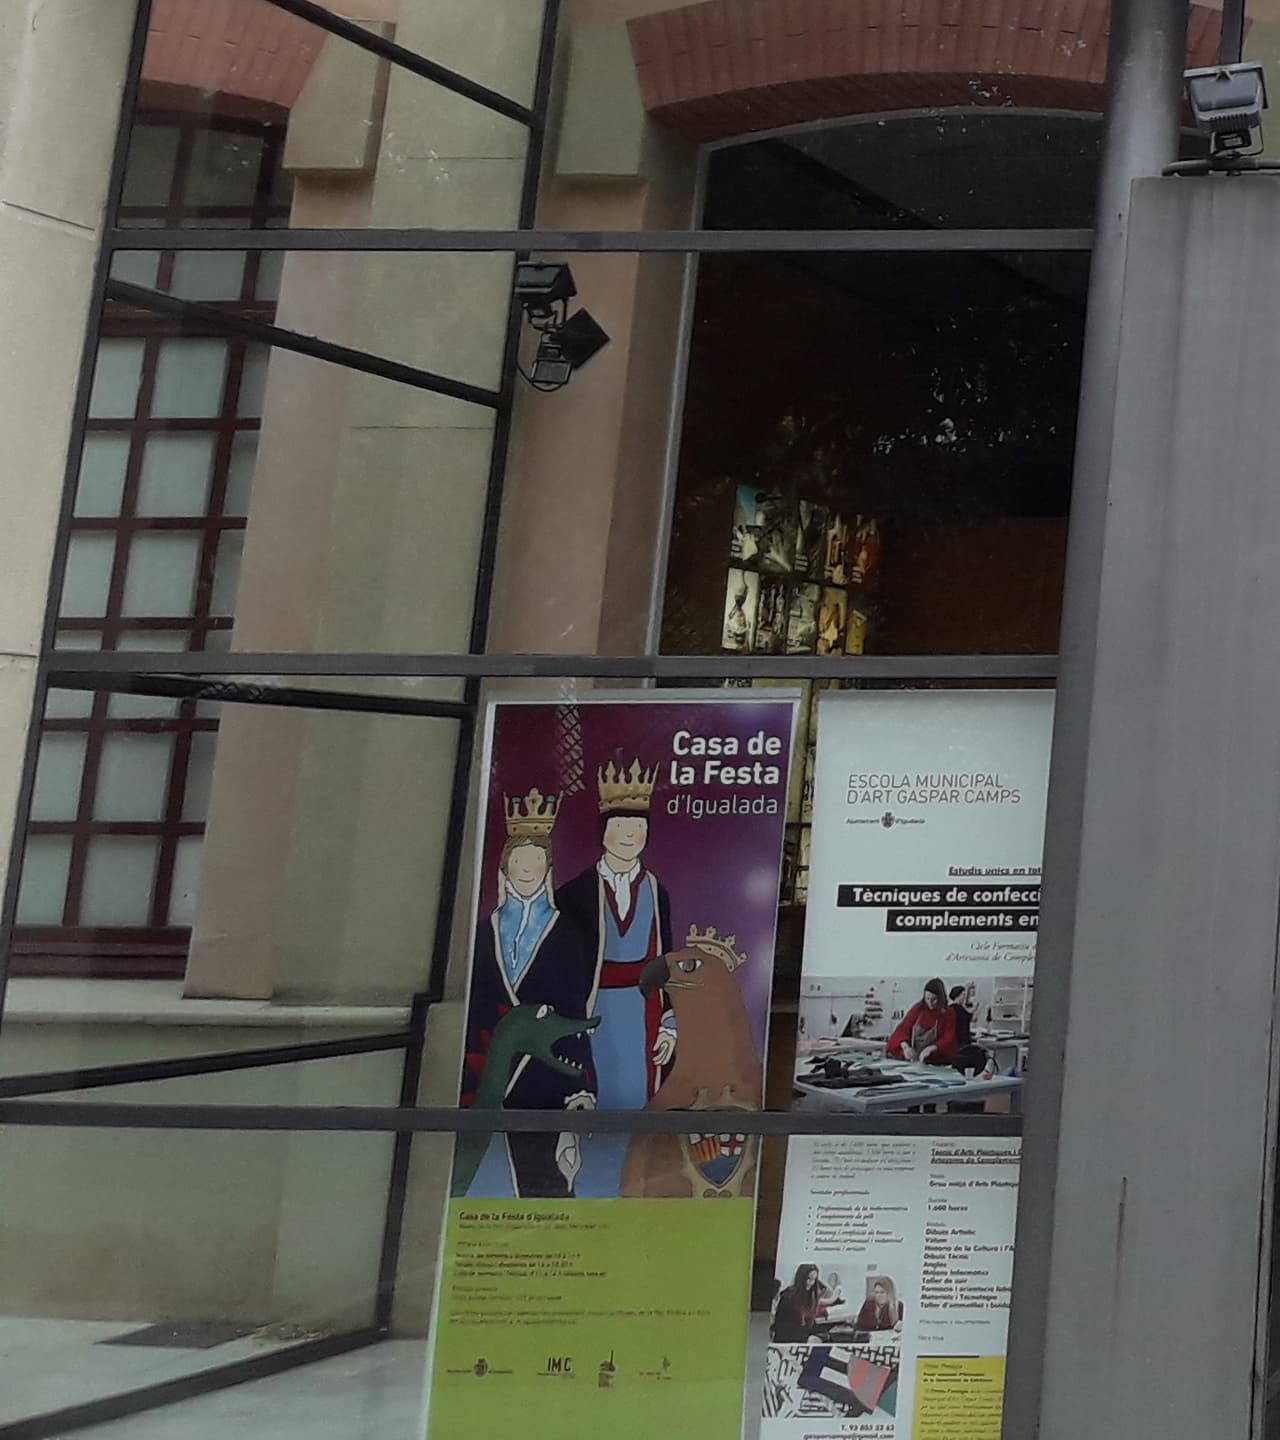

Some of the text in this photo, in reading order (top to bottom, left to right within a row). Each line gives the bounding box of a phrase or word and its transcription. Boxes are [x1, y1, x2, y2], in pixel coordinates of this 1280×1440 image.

[672, 730, 782, 755] Casa de
[670, 760, 780, 785] la Festa
[848, 774, 1004, 789] ESCOLA MUNICIPAL
[847, 789, 1021, 804] D'ART GASPAR CAMPS
[667, 793, 778, 819] d'Igualada
[853, 887, 941, 905] Tècniques
[946, 887, 968, 903] de
[896, 911, 1013, 930] complements
[547, 1357, 572, 1372] IMC
